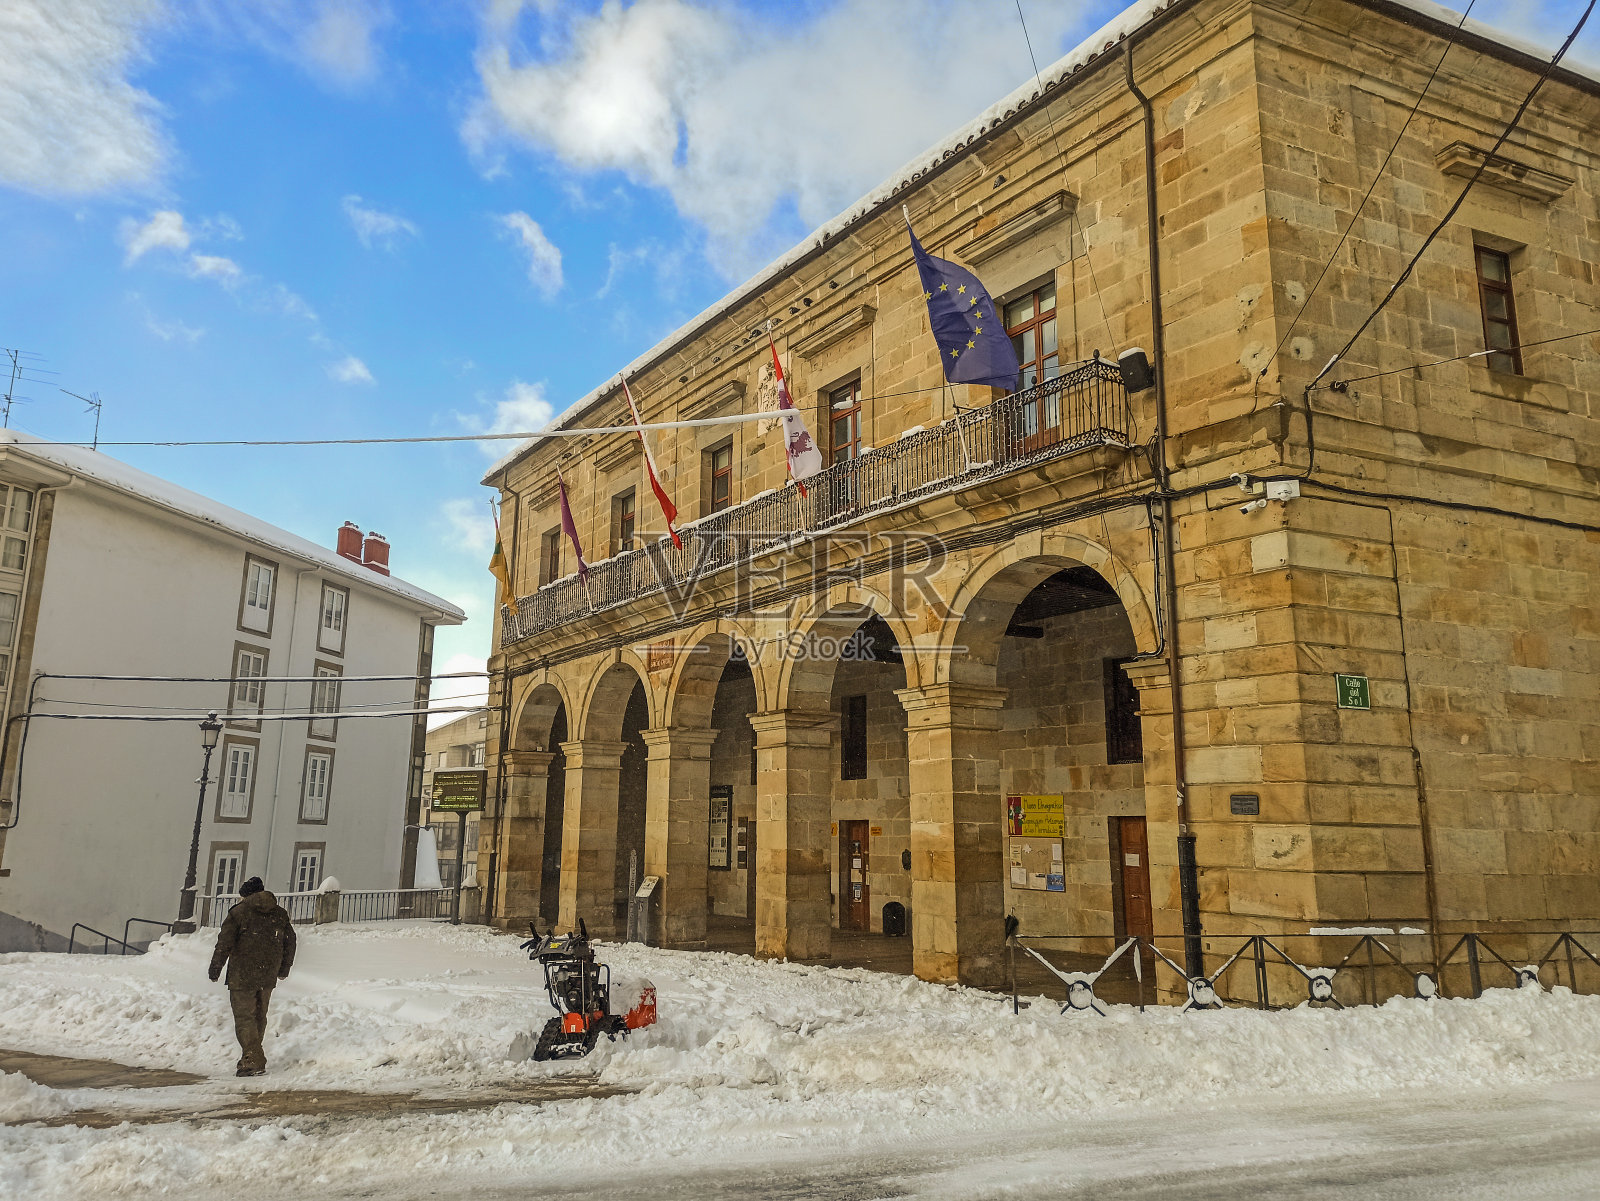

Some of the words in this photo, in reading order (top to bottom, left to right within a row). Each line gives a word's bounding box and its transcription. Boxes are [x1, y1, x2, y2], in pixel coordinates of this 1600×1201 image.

[1346, 678, 1360, 688] Calle
[1350, 688, 1359, 696] del
[1348, 696, 1362, 705] Sol
